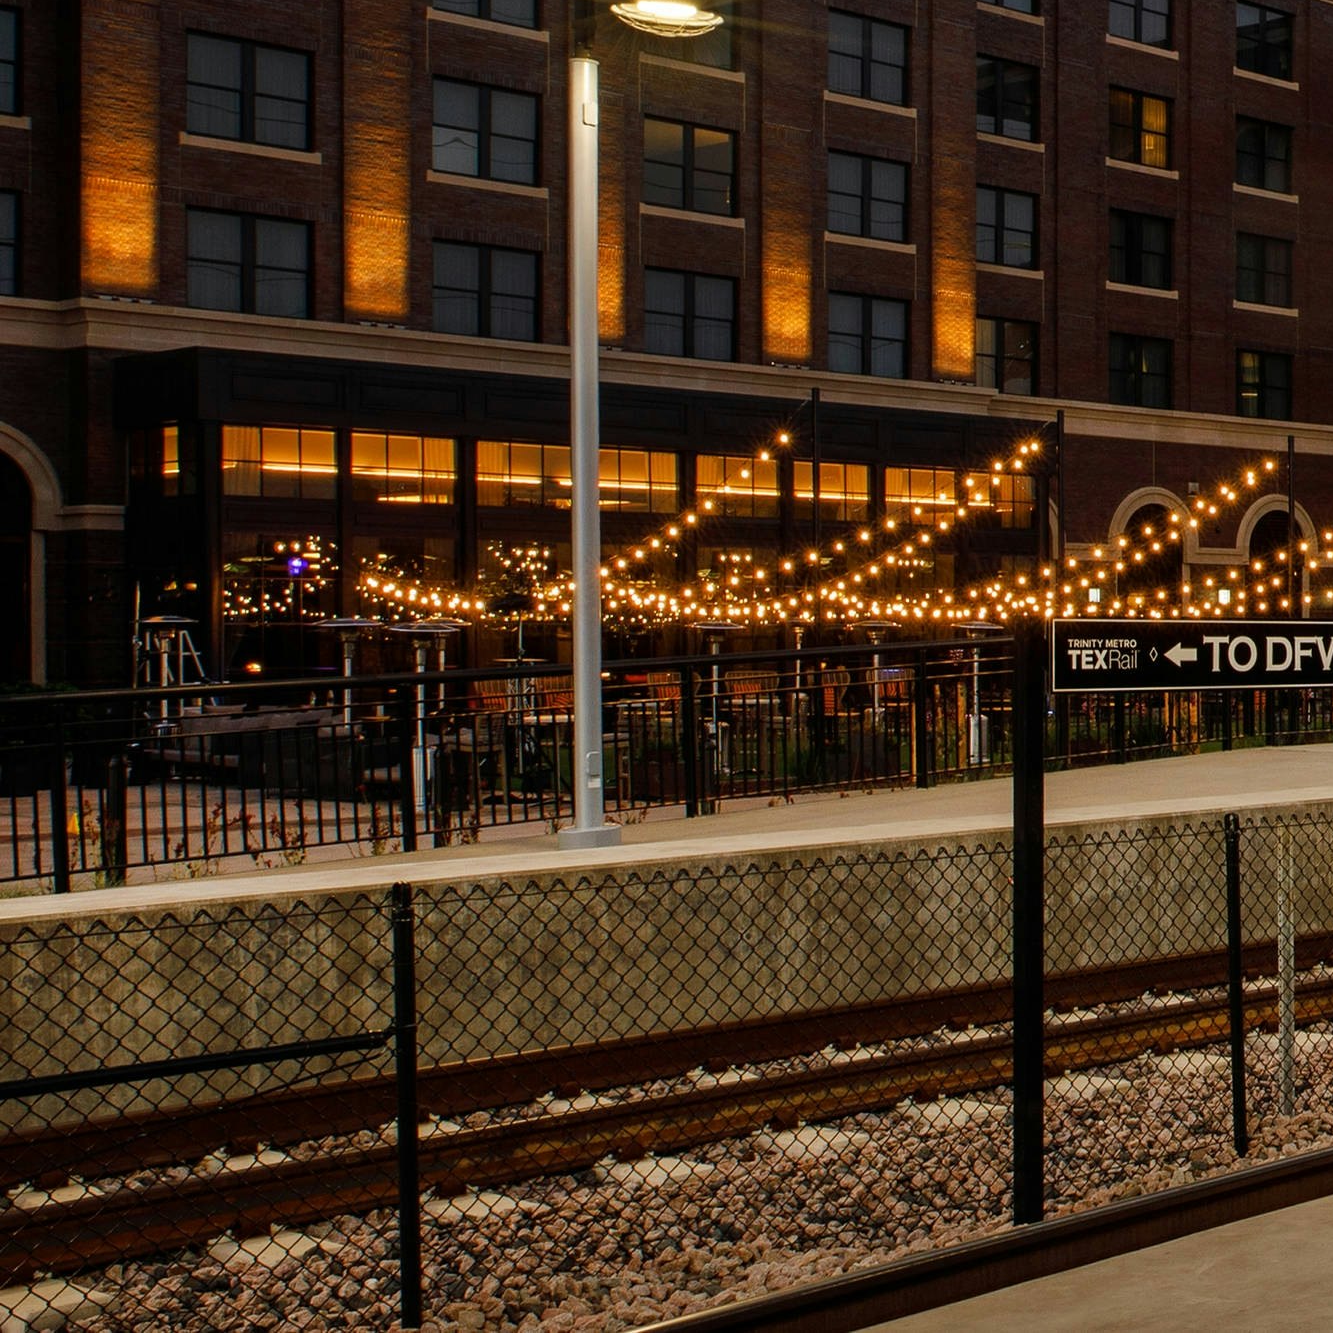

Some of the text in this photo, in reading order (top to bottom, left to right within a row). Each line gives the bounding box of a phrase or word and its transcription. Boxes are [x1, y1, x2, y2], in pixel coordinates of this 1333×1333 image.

[1067, 639, 1137, 648] TRINITY METRO
[1203, 635, 1258, 672] TO
[1067, 649, 1138, 670] TEXRail
